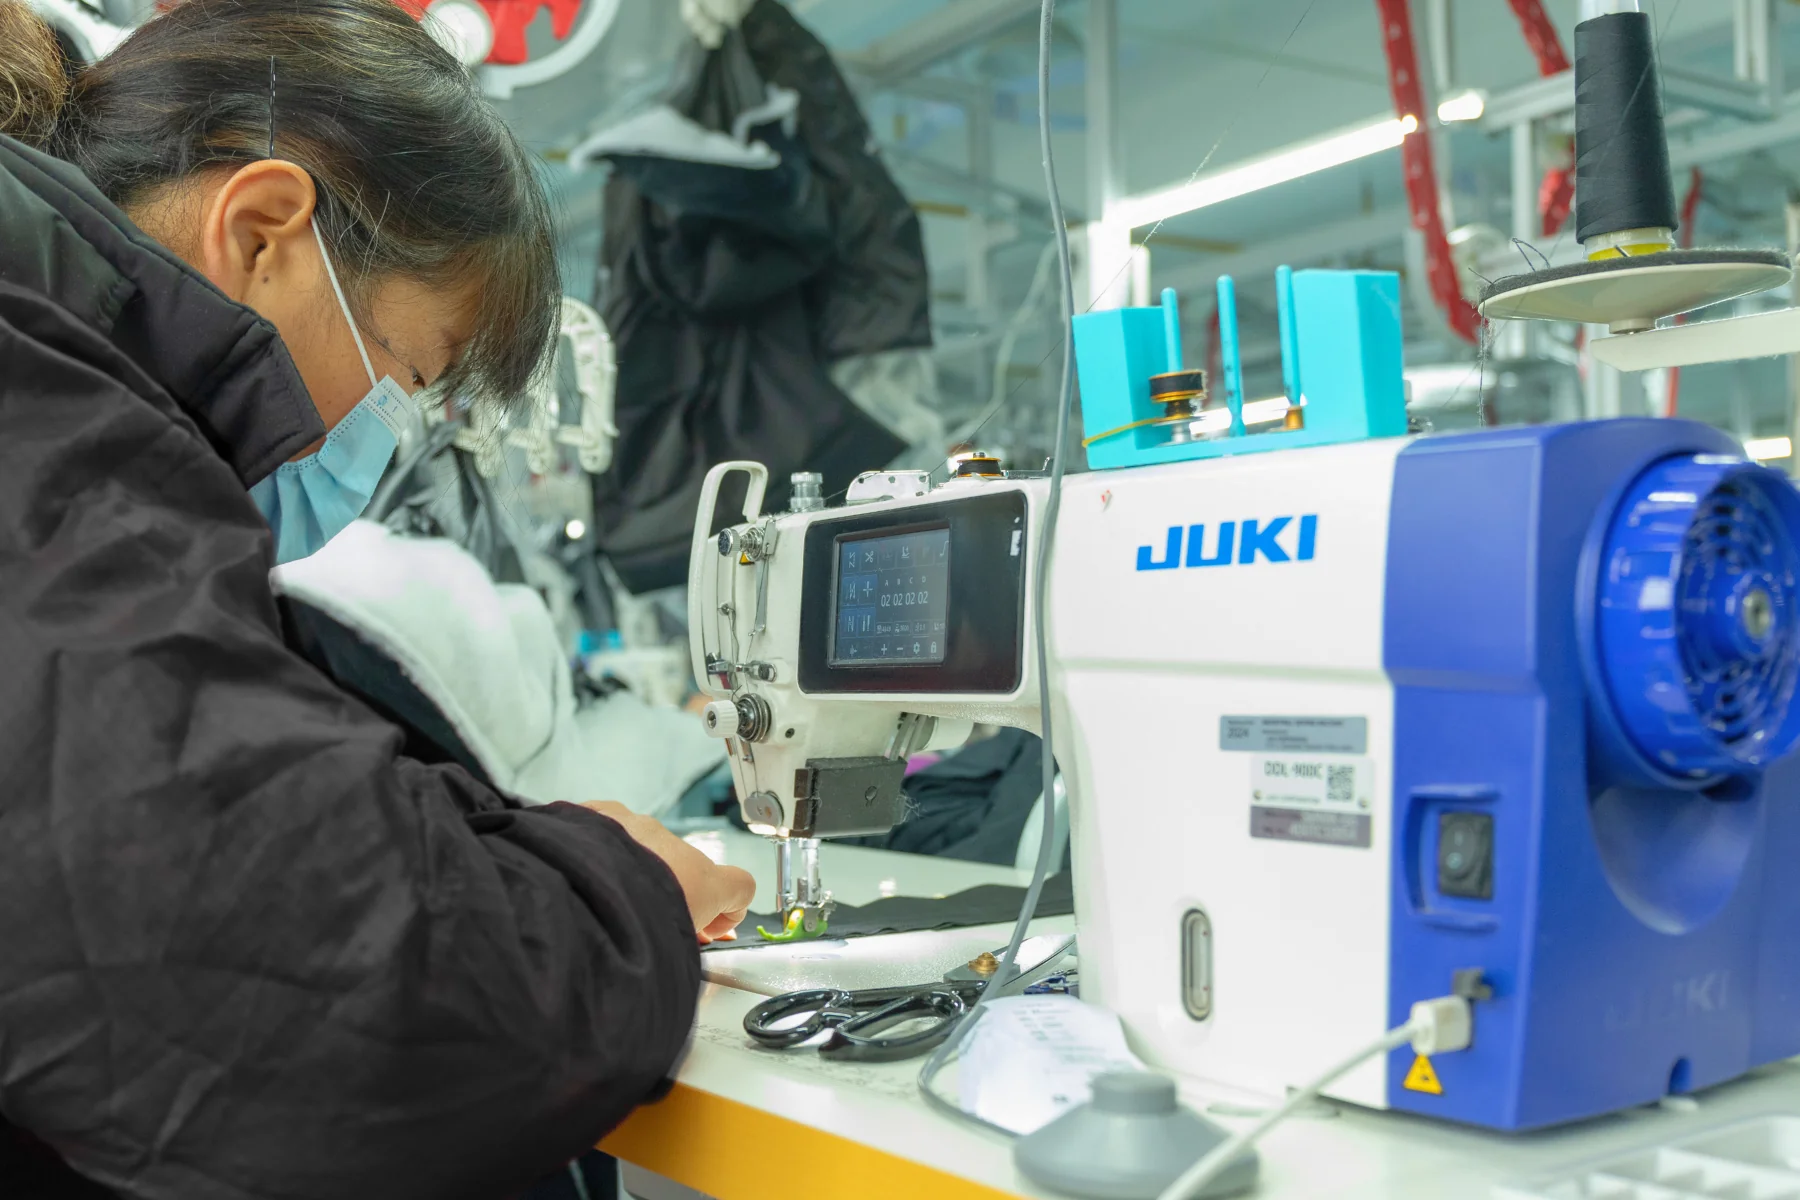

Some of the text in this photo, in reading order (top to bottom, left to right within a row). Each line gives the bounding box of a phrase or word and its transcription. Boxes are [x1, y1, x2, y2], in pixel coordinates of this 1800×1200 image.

[1136, 514, 1318, 571] JUKI
[881, 591, 928, 607] 02 02 02 02
